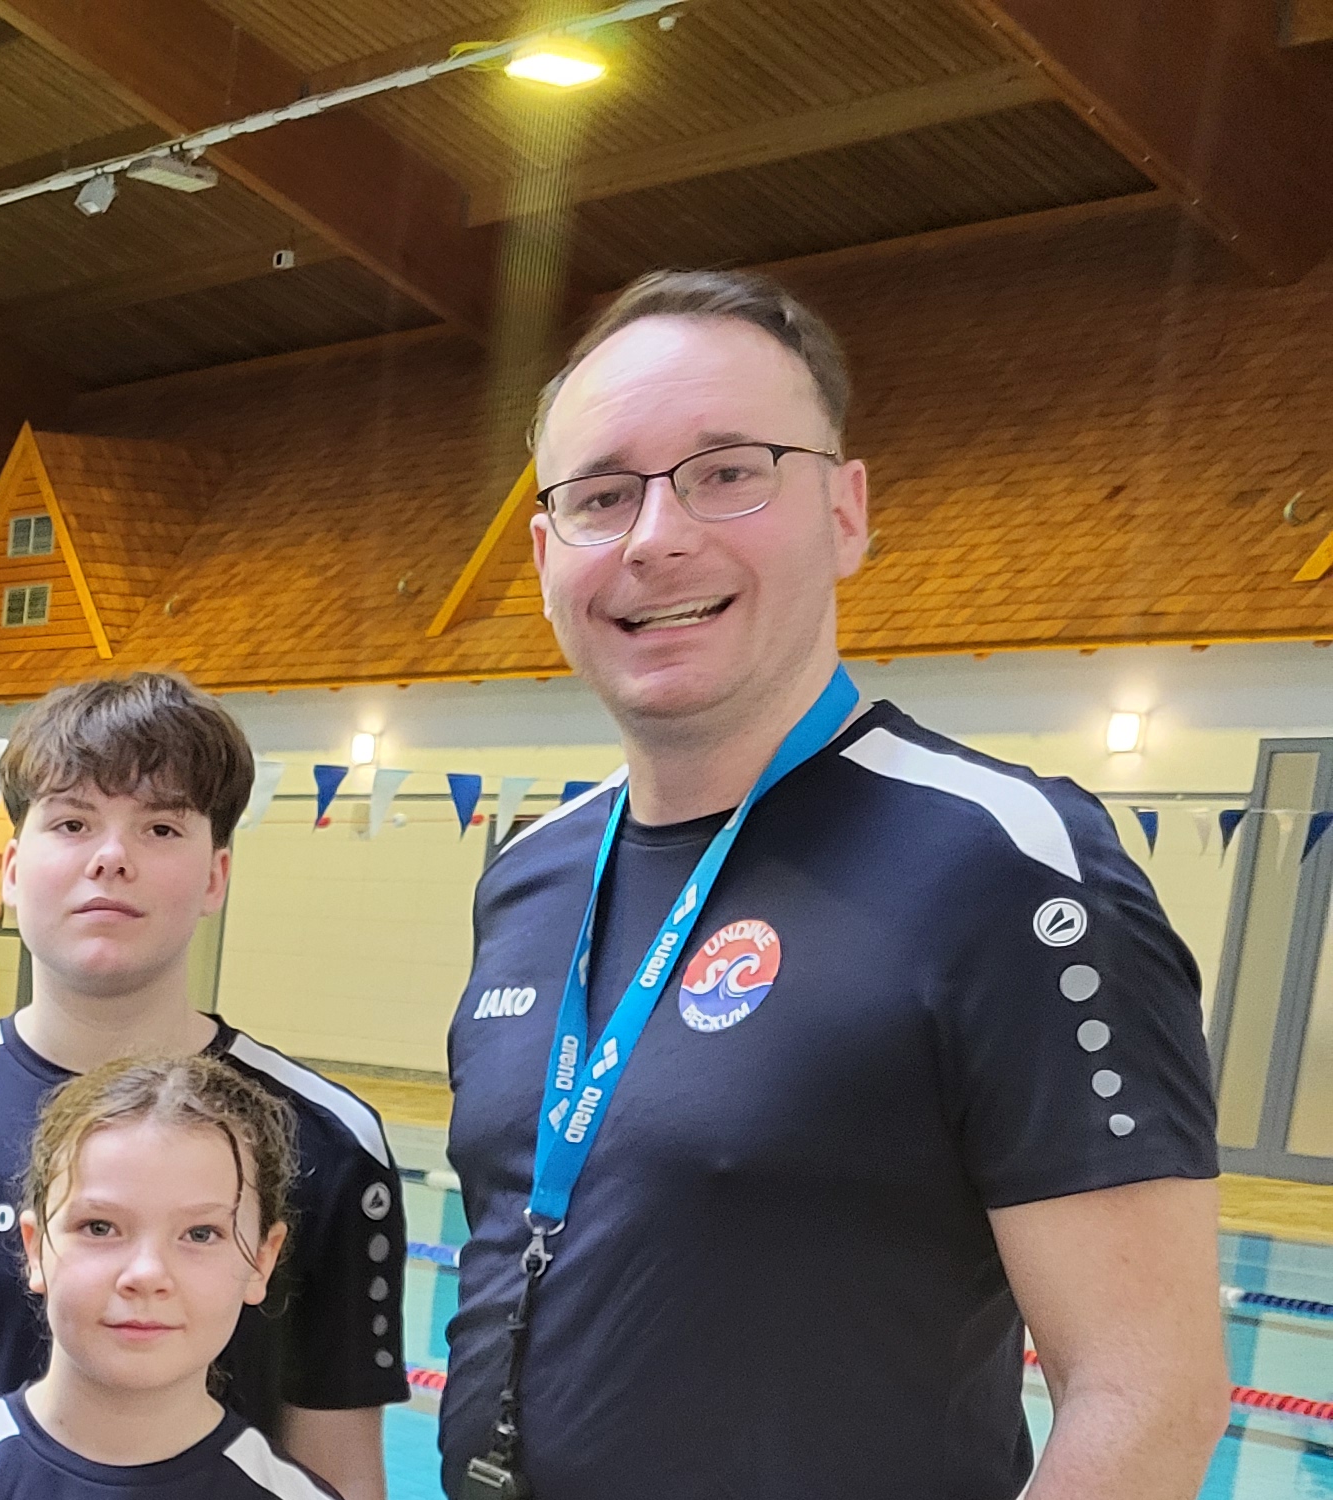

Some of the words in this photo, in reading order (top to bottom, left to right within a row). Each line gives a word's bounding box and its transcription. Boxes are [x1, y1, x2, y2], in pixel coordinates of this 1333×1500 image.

[639, 931, 679, 988] arena
[703, 923, 776, 956] UNDINE
[473, 987, 536, 1020] JAKO
[682, 1002, 751, 1030] BECKUM
[555, 1034, 579, 1091] arena
[564, 1086, 603, 1143] arena
